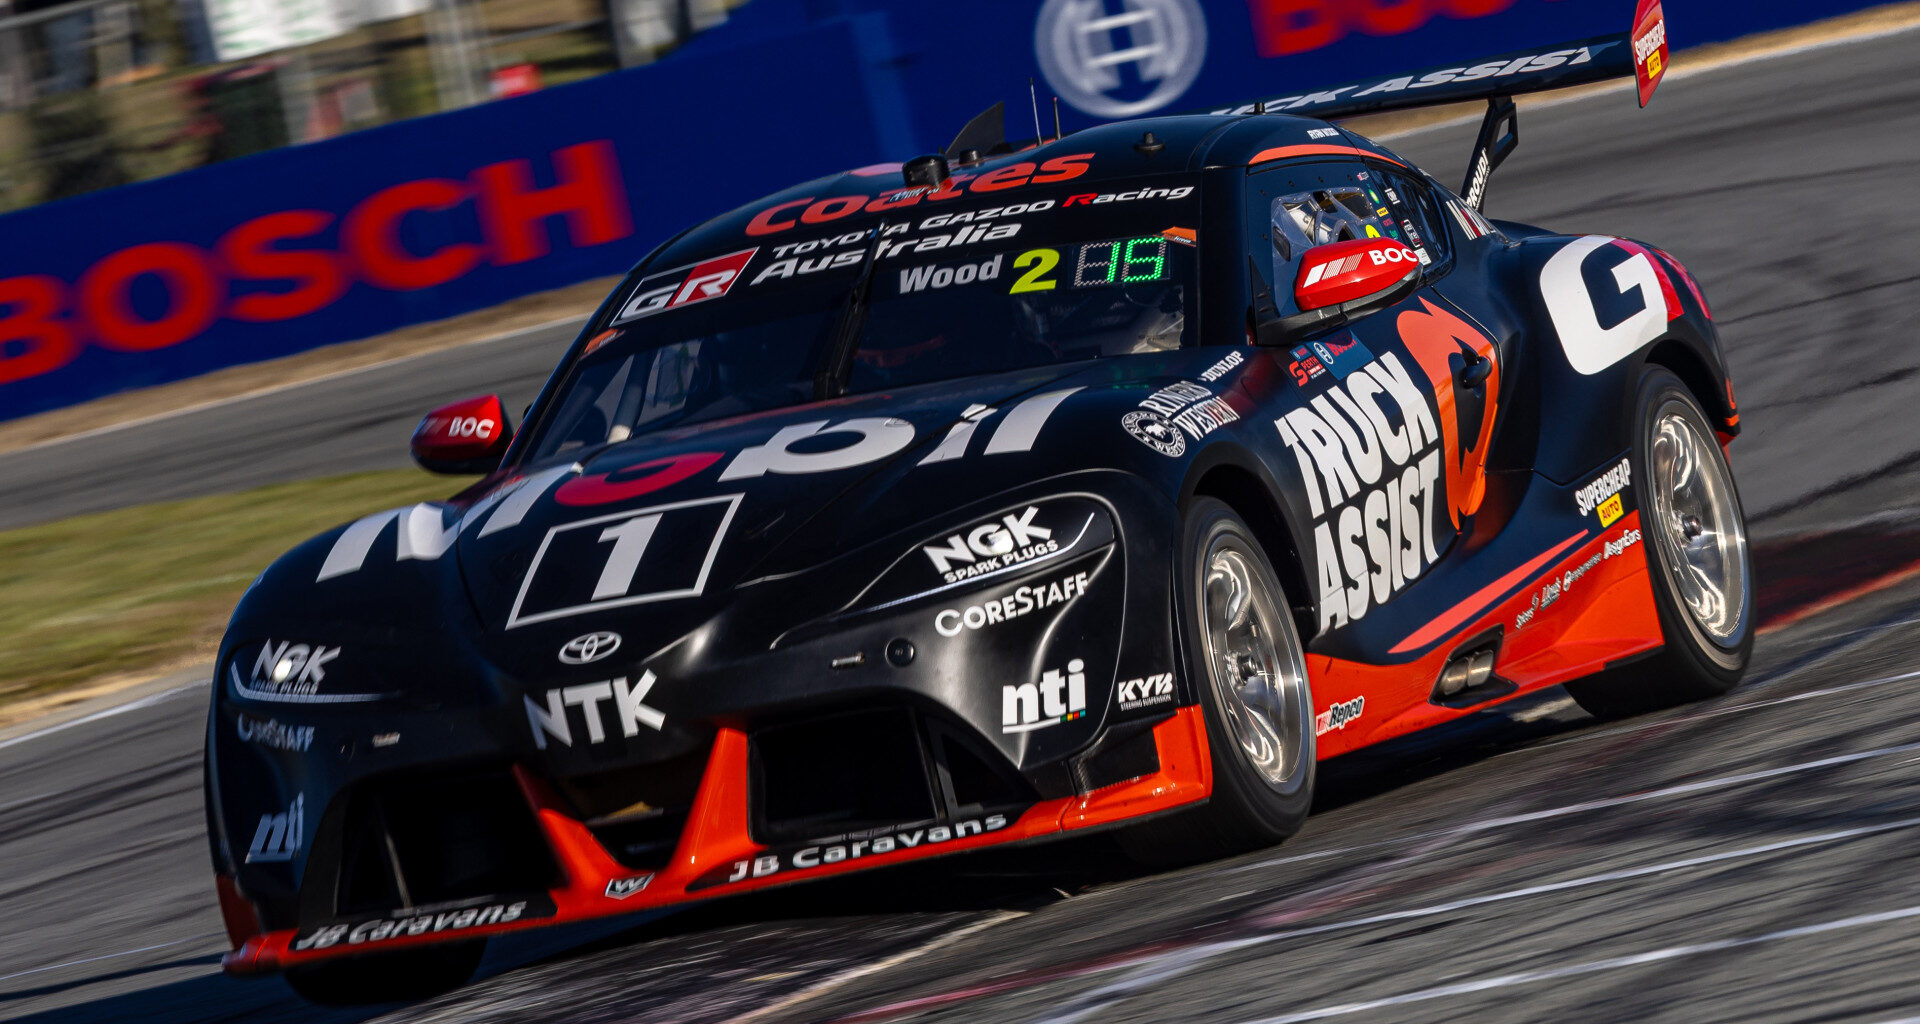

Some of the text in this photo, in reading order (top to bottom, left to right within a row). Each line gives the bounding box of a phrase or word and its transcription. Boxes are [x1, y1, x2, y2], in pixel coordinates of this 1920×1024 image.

[1351, 45, 1594, 98] ASSIST
[745, 153, 1095, 237] coates
[919, 200, 1056, 230] GAZOO
[1063, 184, 1196, 208] Racing
[0, 139, 634, 386] BOSCH
[900, 255, 1001, 294] Wood
[1009, 248, 1061, 294] 2
[1368, 247, 1418, 266] BOC
[620, 268, 738, 320] GR
[1200, 350, 1244, 382] DUNLOP
[448, 416, 495, 439] BOC
[1274, 351, 1439, 519] TRUCK
[315, 386, 1088, 583] Mobil
[1575, 458, 1632, 516] SUPERCHEAP
[1601, 500, 1620, 521] AUTO
[591, 512, 664, 601] 1
[923, 506, 1052, 575] NGK
[943, 540, 1058, 583] SPARK PLUGS
[1313, 448, 1440, 639] ASSIST
[251, 638, 342, 683] NGK
[523, 669, 667, 750] NTK
[1003, 658, 1086, 726] nti
[1118, 672, 1173, 704] KYB
[1328, 696, 1364, 729] Repco
[728, 813, 1007, 883] JB Caravans
[295, 901, 528, 951] JB Caravans
